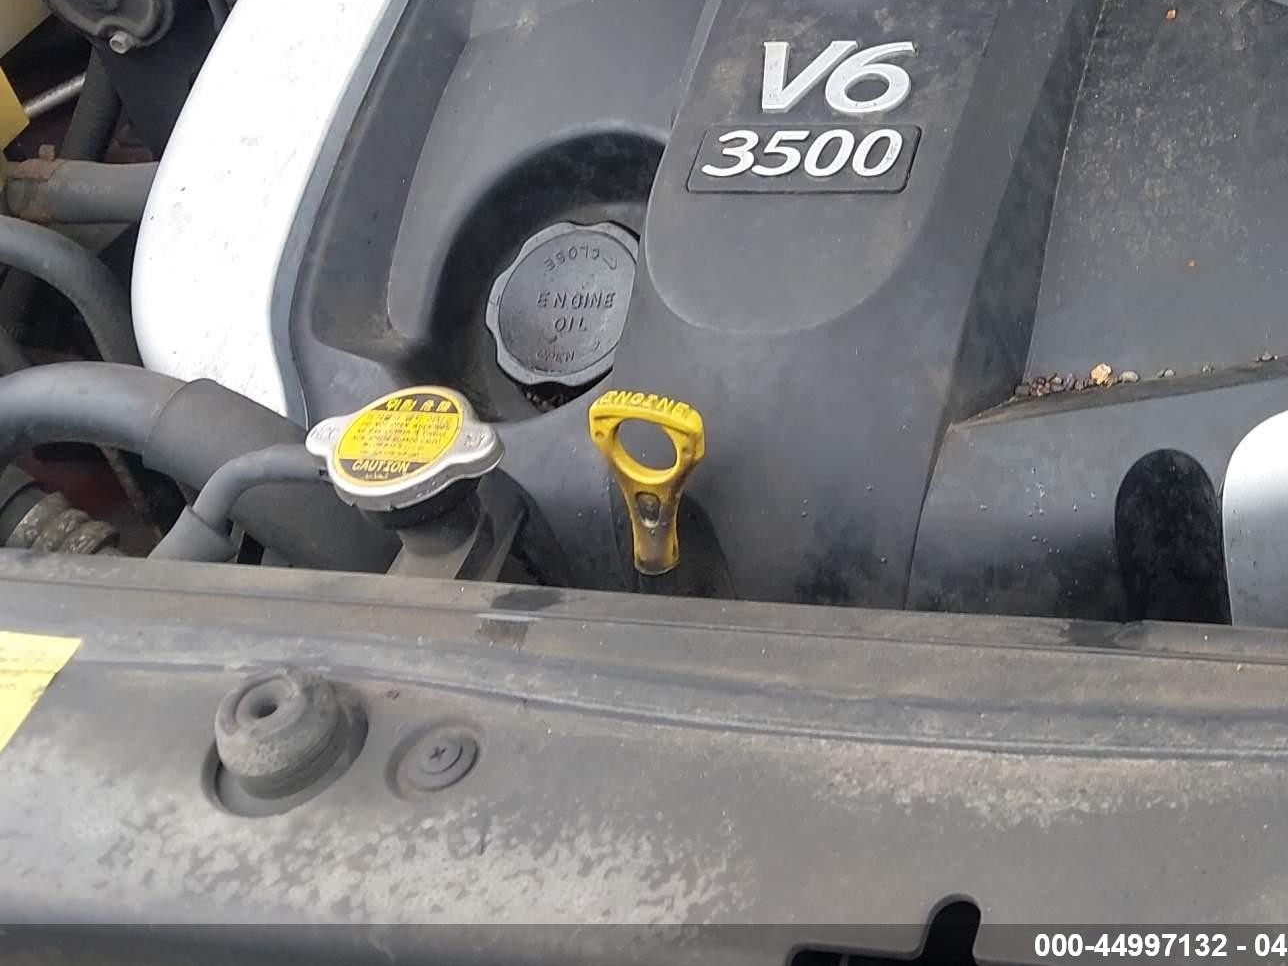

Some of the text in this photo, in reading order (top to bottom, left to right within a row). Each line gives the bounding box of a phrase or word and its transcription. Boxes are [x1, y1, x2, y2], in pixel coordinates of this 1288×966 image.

[761, 40, 918, 114] V6
[701, 129, 904, 177] 3500
[543, 243, 600, 272] CLOSE
[537, 291, 616, 309] ENGINE
[554, 316, 588, 332] OIL
[599, 390, 691, 418] ENGINE
[352, 460, 410, 474] CAUTION
